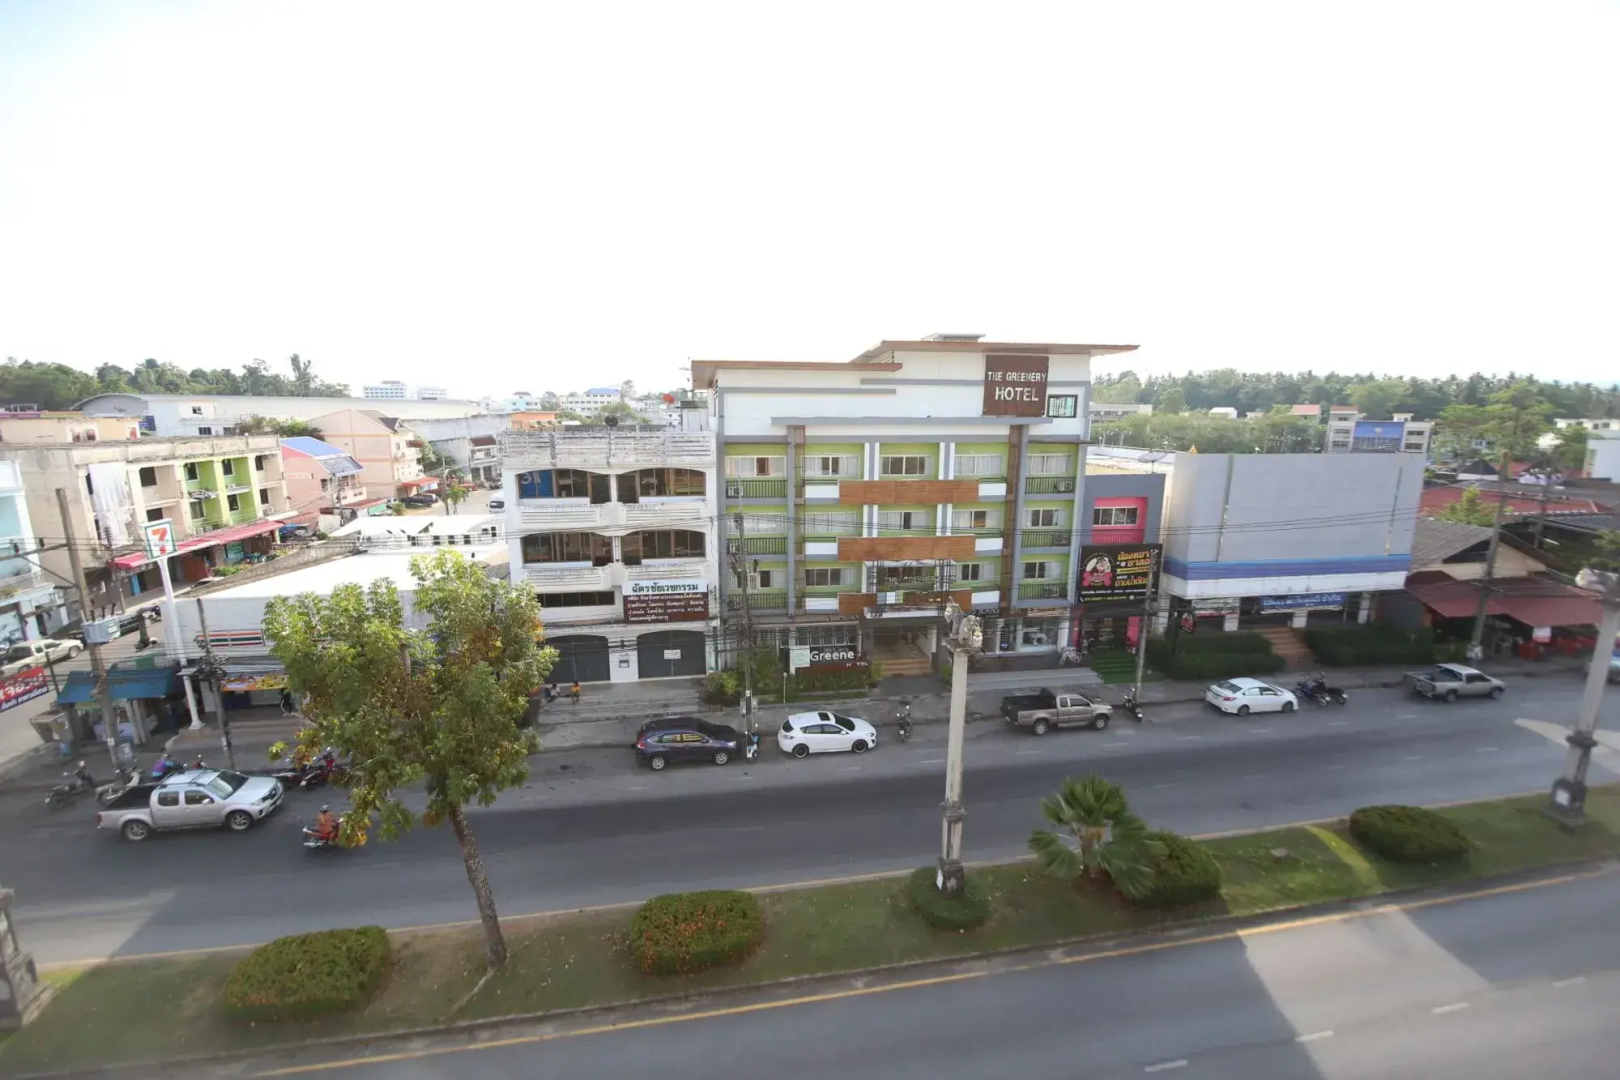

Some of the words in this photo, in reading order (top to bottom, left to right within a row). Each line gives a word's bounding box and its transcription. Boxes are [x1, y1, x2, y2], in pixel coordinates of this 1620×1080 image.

[988, 371, 1003, 382] THE
[1006, 371, 1047, 382] GREENERY
[995, 386, 1039, 401] HOTEL
[810, 650, 855, 661] Greene
